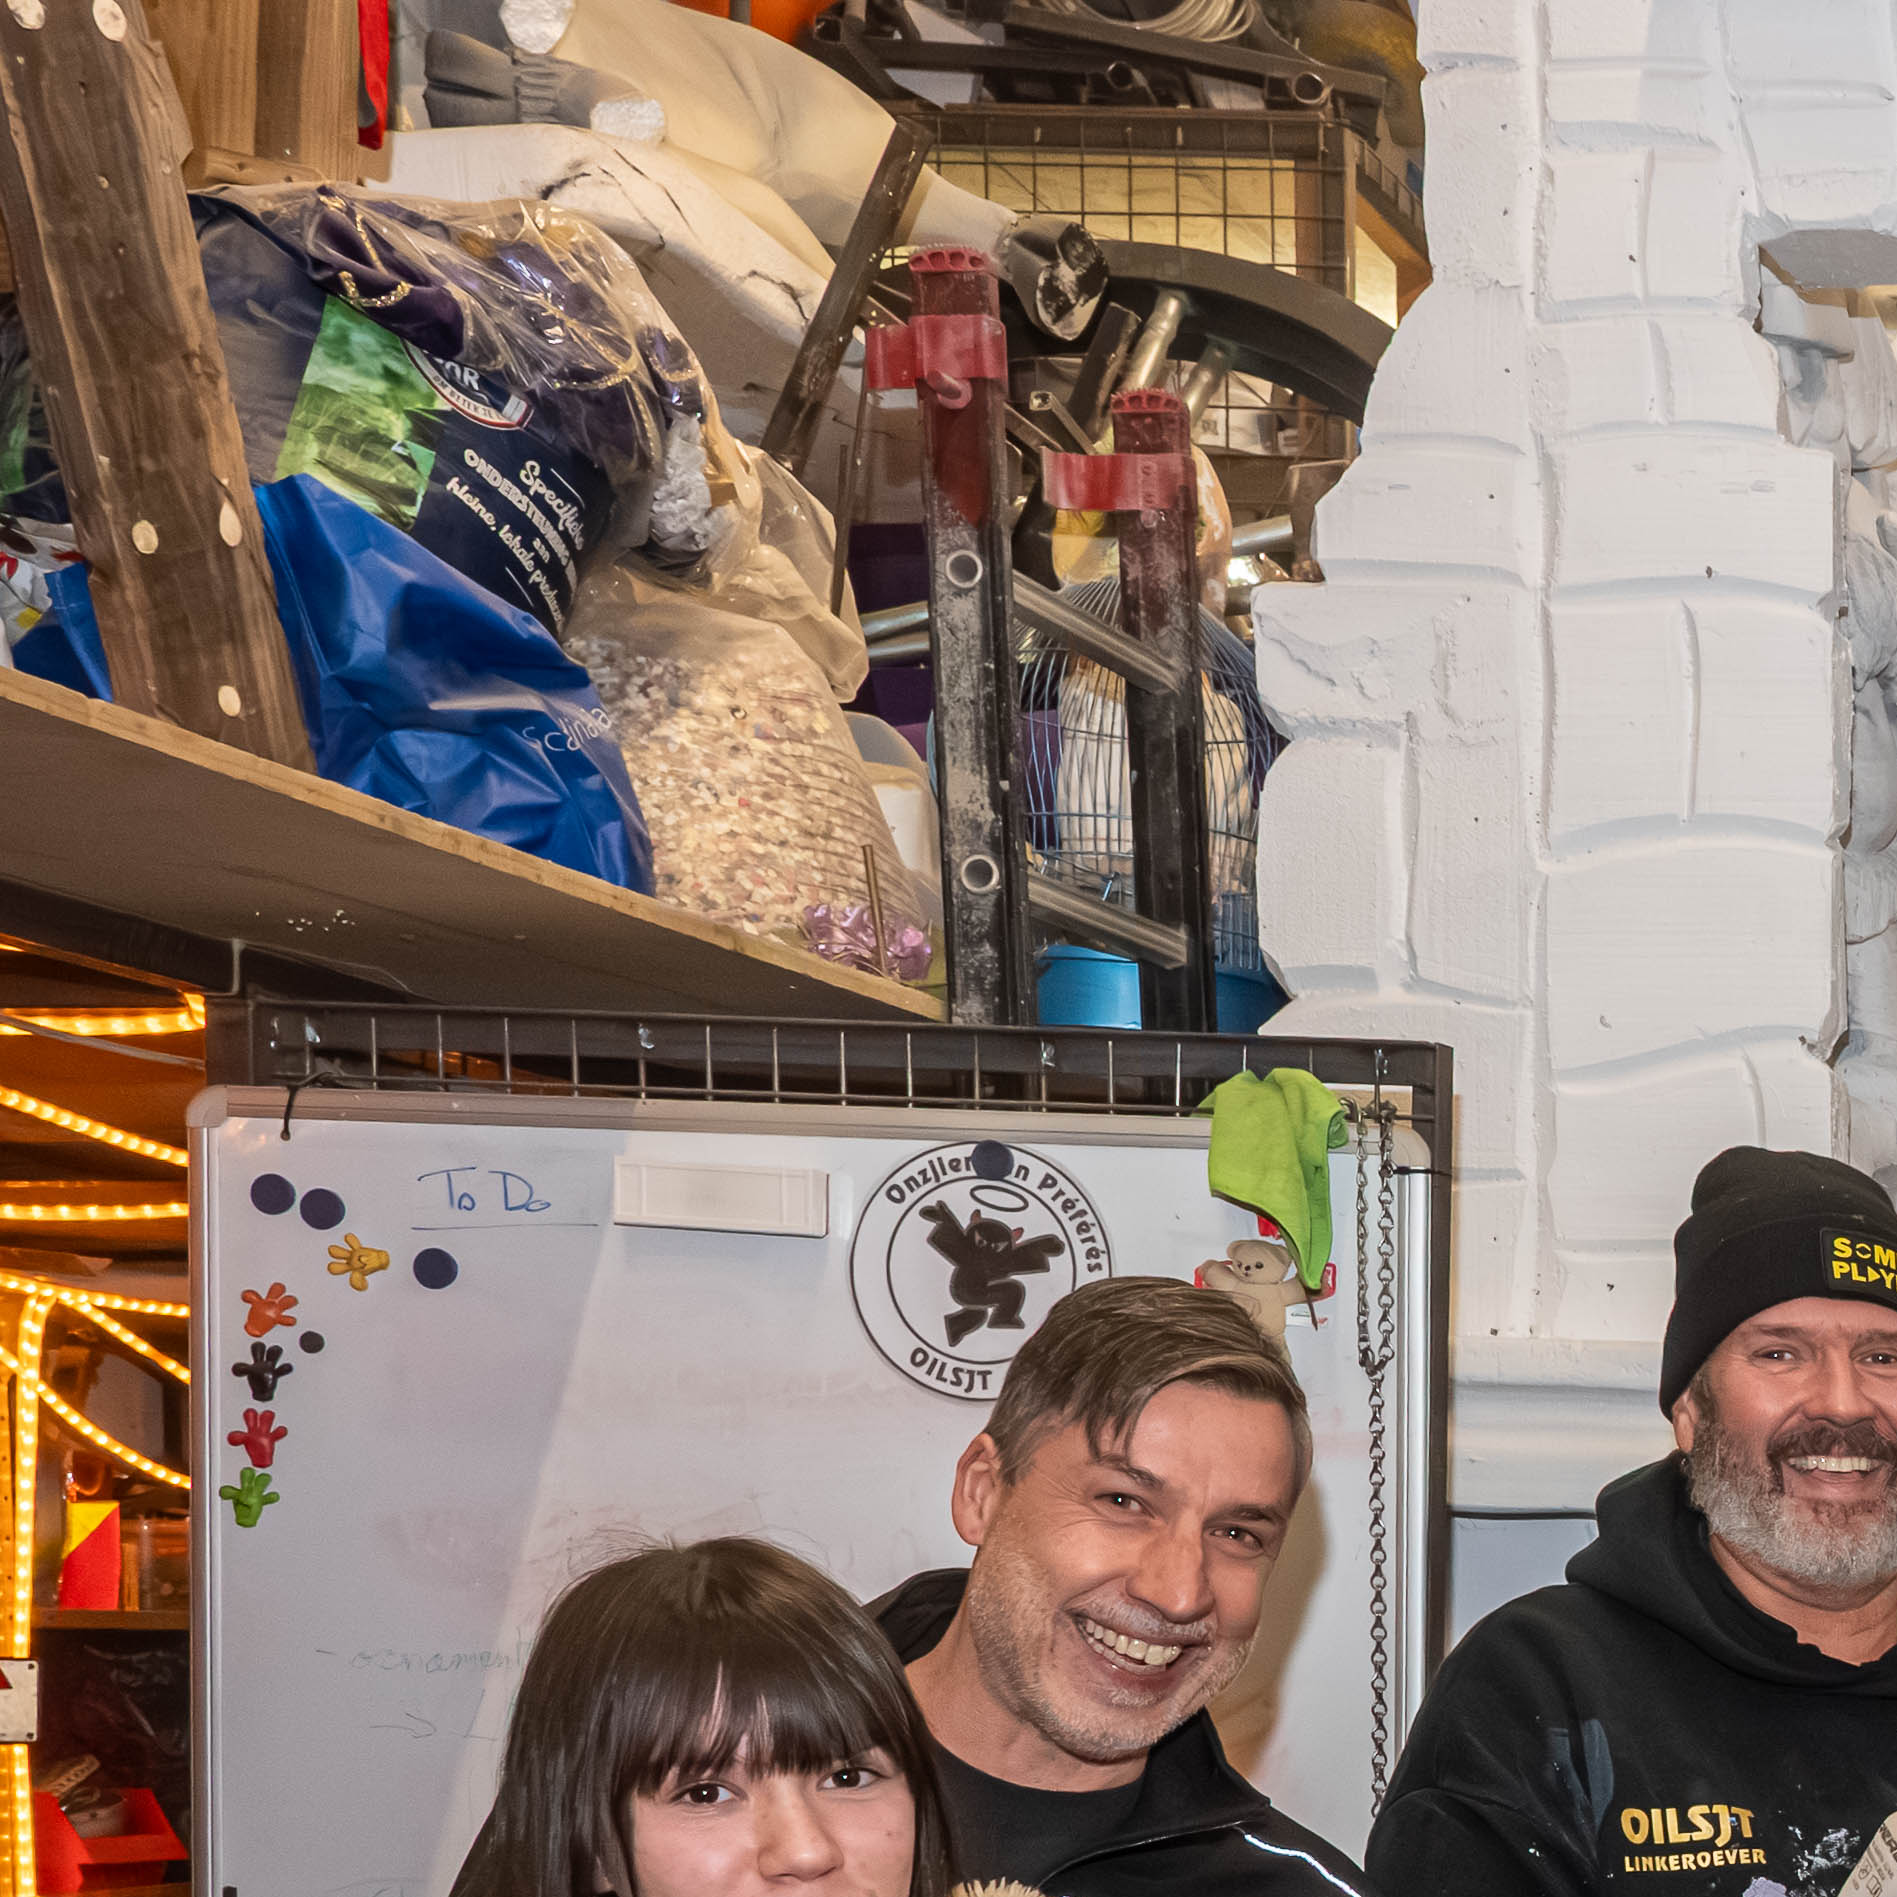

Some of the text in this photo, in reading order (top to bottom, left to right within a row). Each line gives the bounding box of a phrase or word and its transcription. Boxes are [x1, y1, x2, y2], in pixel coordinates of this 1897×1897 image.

[417, 1166, 552, 1212] To Do
[909, 1347, 993, 1393] OILSJT
[1620, 1803, 1755, 1848] OILSJT
[1624, 1847, 1768, 1873] LINKEROEVER
